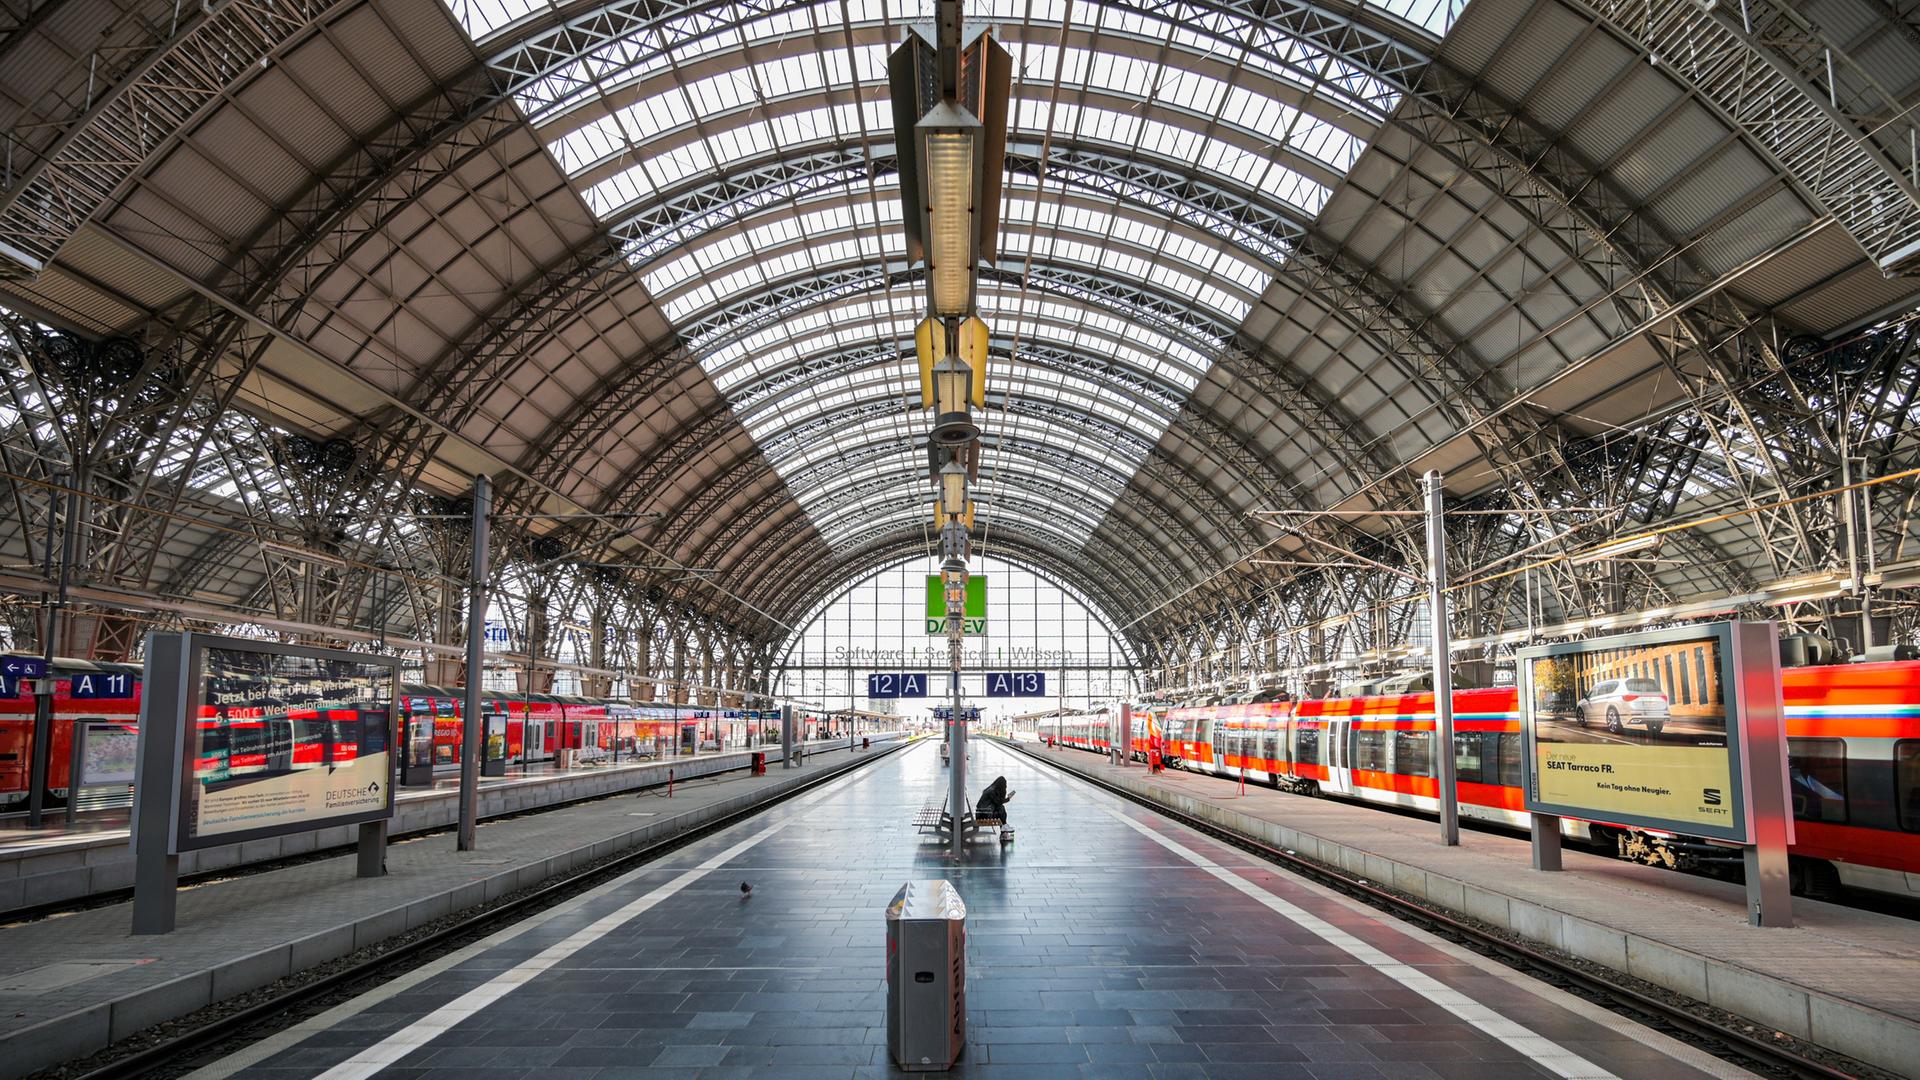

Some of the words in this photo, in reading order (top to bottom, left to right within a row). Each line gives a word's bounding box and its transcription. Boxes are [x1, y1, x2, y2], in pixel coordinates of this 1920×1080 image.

[927, 619, 984, 633] DAEV
[835, 646, 903, 660] Software
[925, 646, 986, 661] Serice
[1011, 646, 1073, 660] Wissen
[78, 675, 94, 693] A
[107, 674, 125, 693] 11
[871, 674, 893, 693] 12
[904, 674, 920, 693] A
[993, 674, 1009, 692] A
[1016, 673, 1038, 692] 13
[214, 691, 245, 705] Jetzt
[1546, 751, 1557, 760] Der
[1547, 760, 1566, 770] SEAT
[1567, 762, 1599, 773] Tarraco
[1601, 764, 1615, 774] FR.
[326, 787, 368, 801] DEUTSCHE
[1597, 782, 1611, 790] Kein
[1611, 783, 1623, 792] Tag
[1641, 786, 1672, 795] Neugier.
[1698, 807, 1728, 815] SEAT
